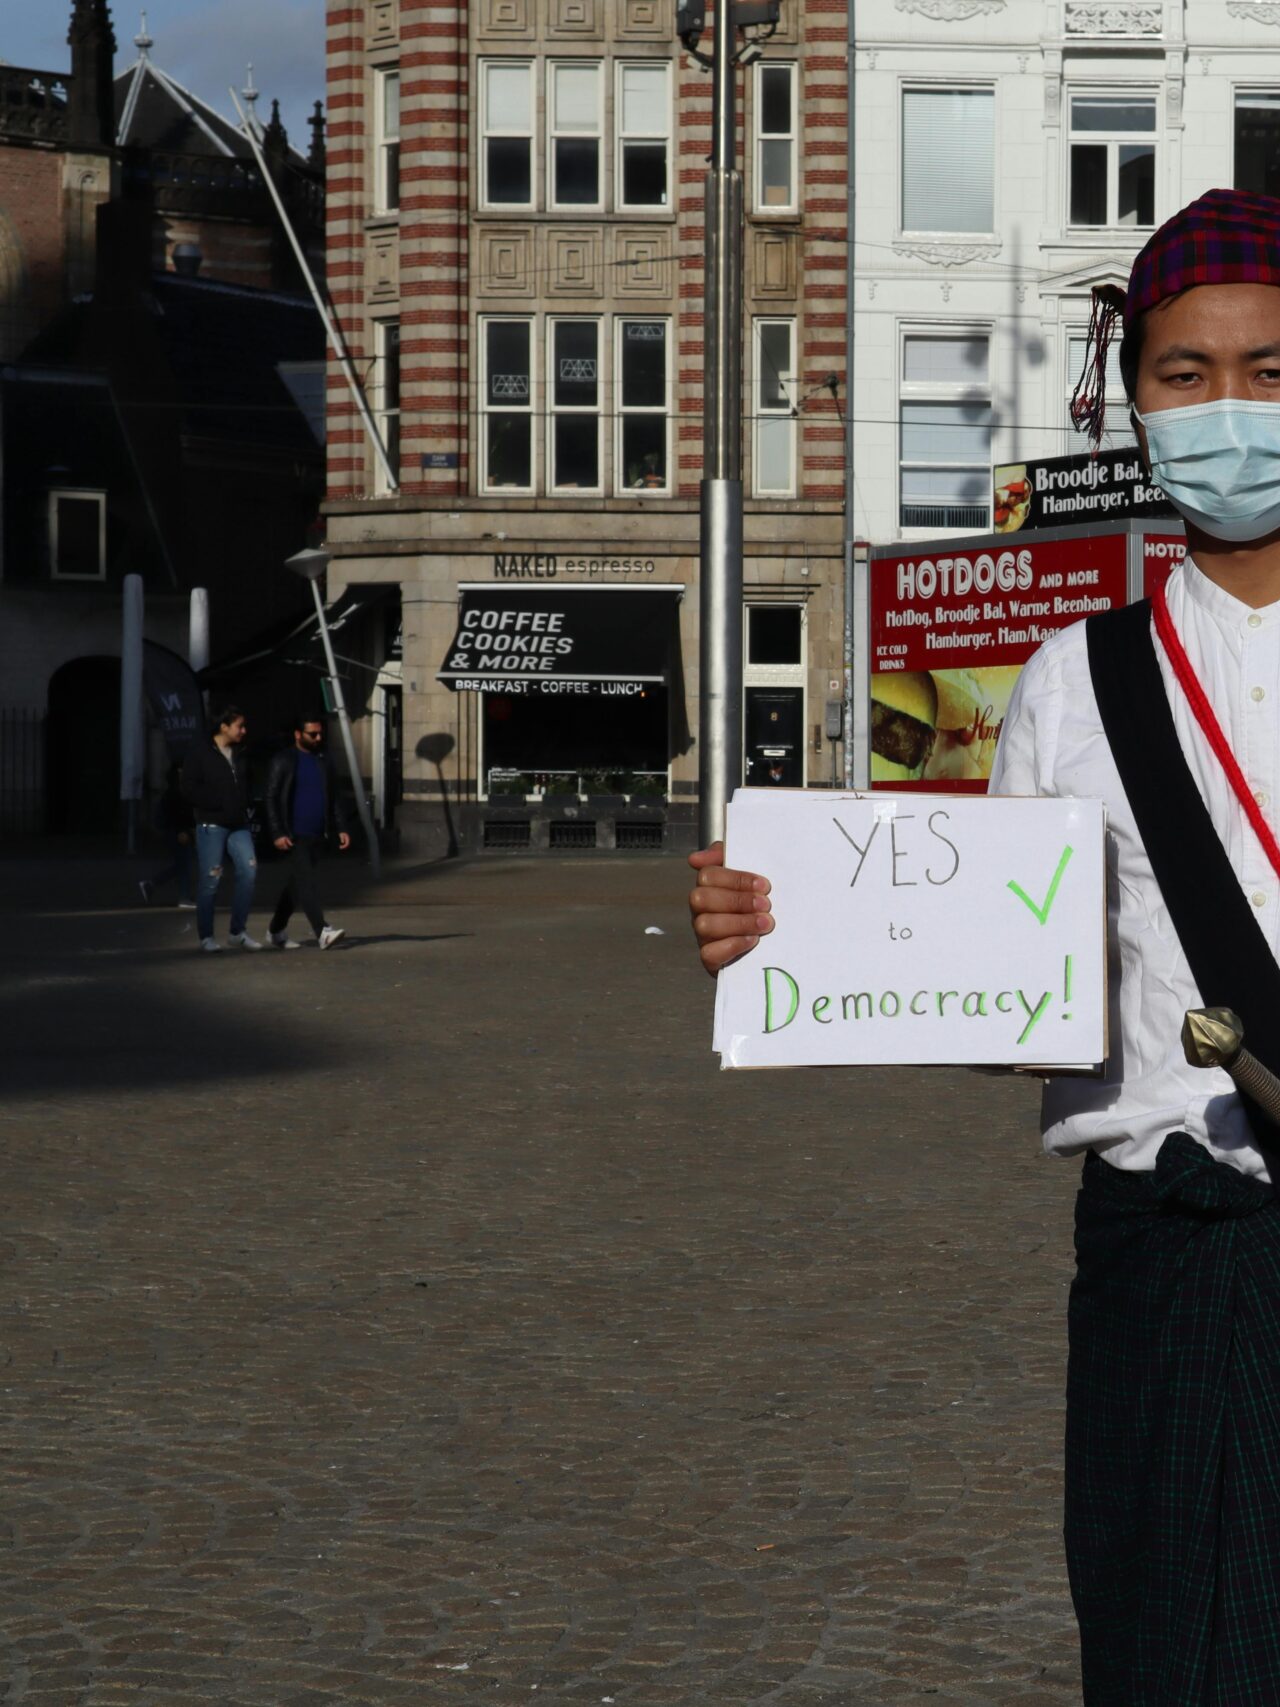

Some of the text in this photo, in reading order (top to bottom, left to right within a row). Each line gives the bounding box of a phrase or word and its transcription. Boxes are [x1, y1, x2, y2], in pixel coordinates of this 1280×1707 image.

[1035, 460, 1143, 491] Broodje Bal,
[1042, 491, 1130, 514] Hamburger,
[494, 554, 655, 578] NAKED espresso
[897, 550, 1099, 600] HOTDOGS AND MORE
[463, 609, 566, 633] COFFEE
[885, 595, 1112, 629] HotDog, Broodje Bal, Warme Beenham
[456, 631, 574, 654] COOKIES
[876, 644, 908, 657] ICE COLD
[925, 631, 995, 651] Hamburger,
[449, 653, 557, 671] & MORE
[879, 659, 905, 670] DRINKS
[455, 679, 528, 693] BREAKFAST
[541, 680, 590, 694] COFFEE
[601, 682, 643, 695] LUNCH
[832, 811, 960, 887] YES
[888, 922, 913, 941] to
[761, 954, 1073, 1045] Democracy!
